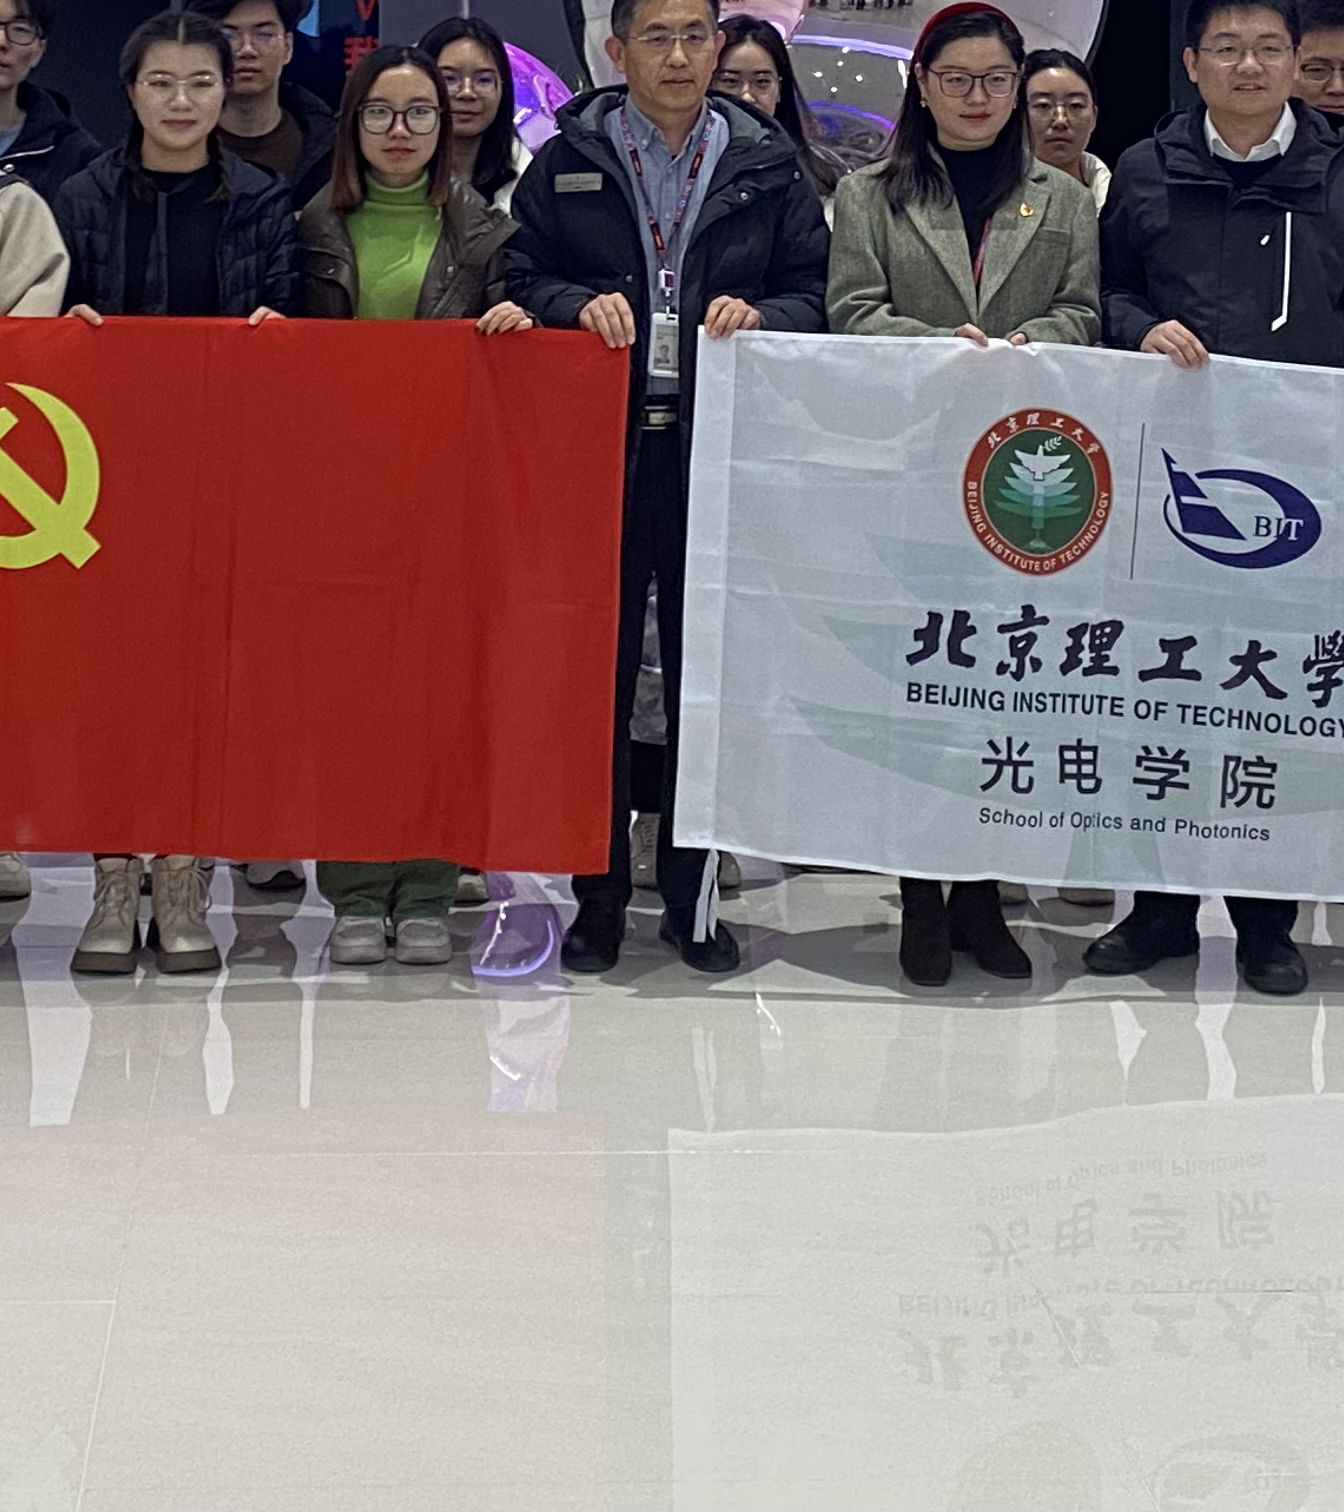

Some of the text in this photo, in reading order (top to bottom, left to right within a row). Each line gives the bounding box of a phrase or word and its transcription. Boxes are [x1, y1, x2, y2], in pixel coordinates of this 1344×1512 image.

[966, 481, 1109, 571] BEIJING INSTITUTE OF TECHNOLOGY
[1253, 516, 1304, 541] BIT
[907, 682, 1005, 712] BEIJING
[1013, 691, 1125, 717] INSTITUTE
[1134, 699, 1169, 721] OF
[979, 736, 1278, 809] 光电学院
[979, 807, 1270, 841] School of Optics and Photonics
